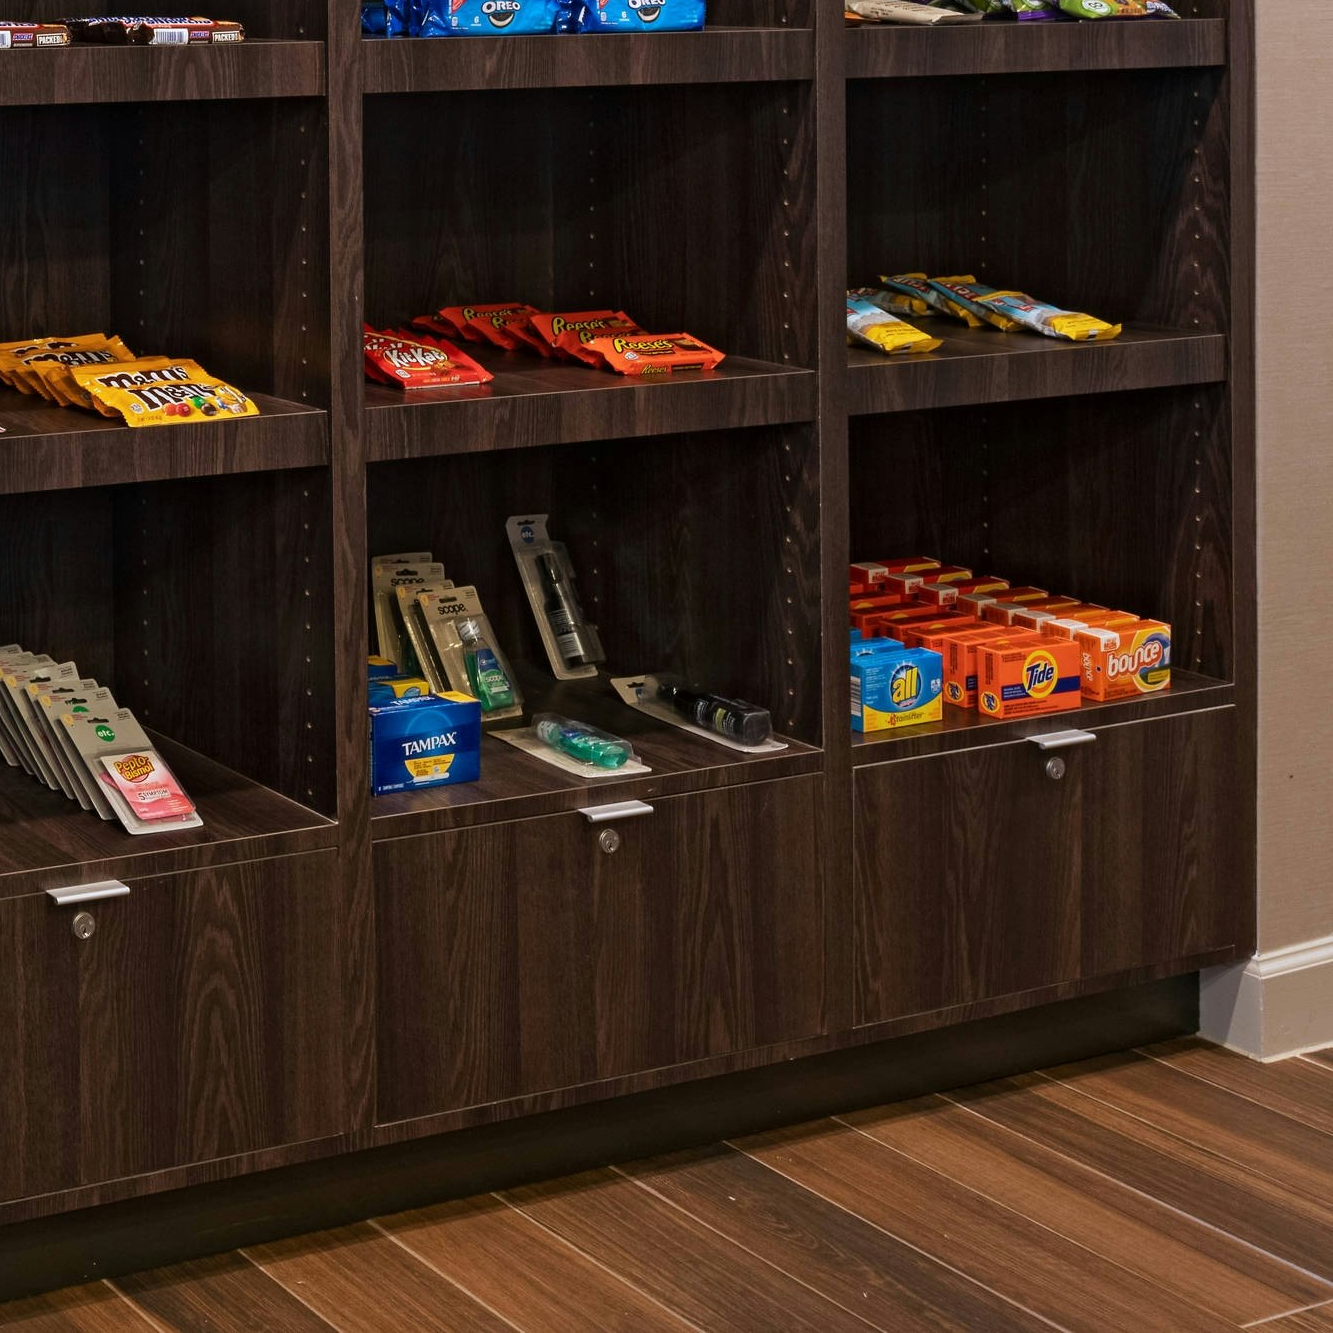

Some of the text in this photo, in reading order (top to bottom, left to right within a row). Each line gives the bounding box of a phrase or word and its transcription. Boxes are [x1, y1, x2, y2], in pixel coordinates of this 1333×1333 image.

[482, 0, 521, 14] OREO
[613, 337, 674, 355] Reese's
[641, 364, 668, 376] Reese's
[437, 603, 468, 616] scope
[1107, 641, 1163, 680] bounce
[891, 666, 919, 703] all
[1025, 661, 1055, 692] Tide
[96, 728, 116, 739] etc.
[401, 731, 457, 757] TAMPAX
[113, 754, 149, 774] Pepto-
[124, 762, 156, 782] Bismol
